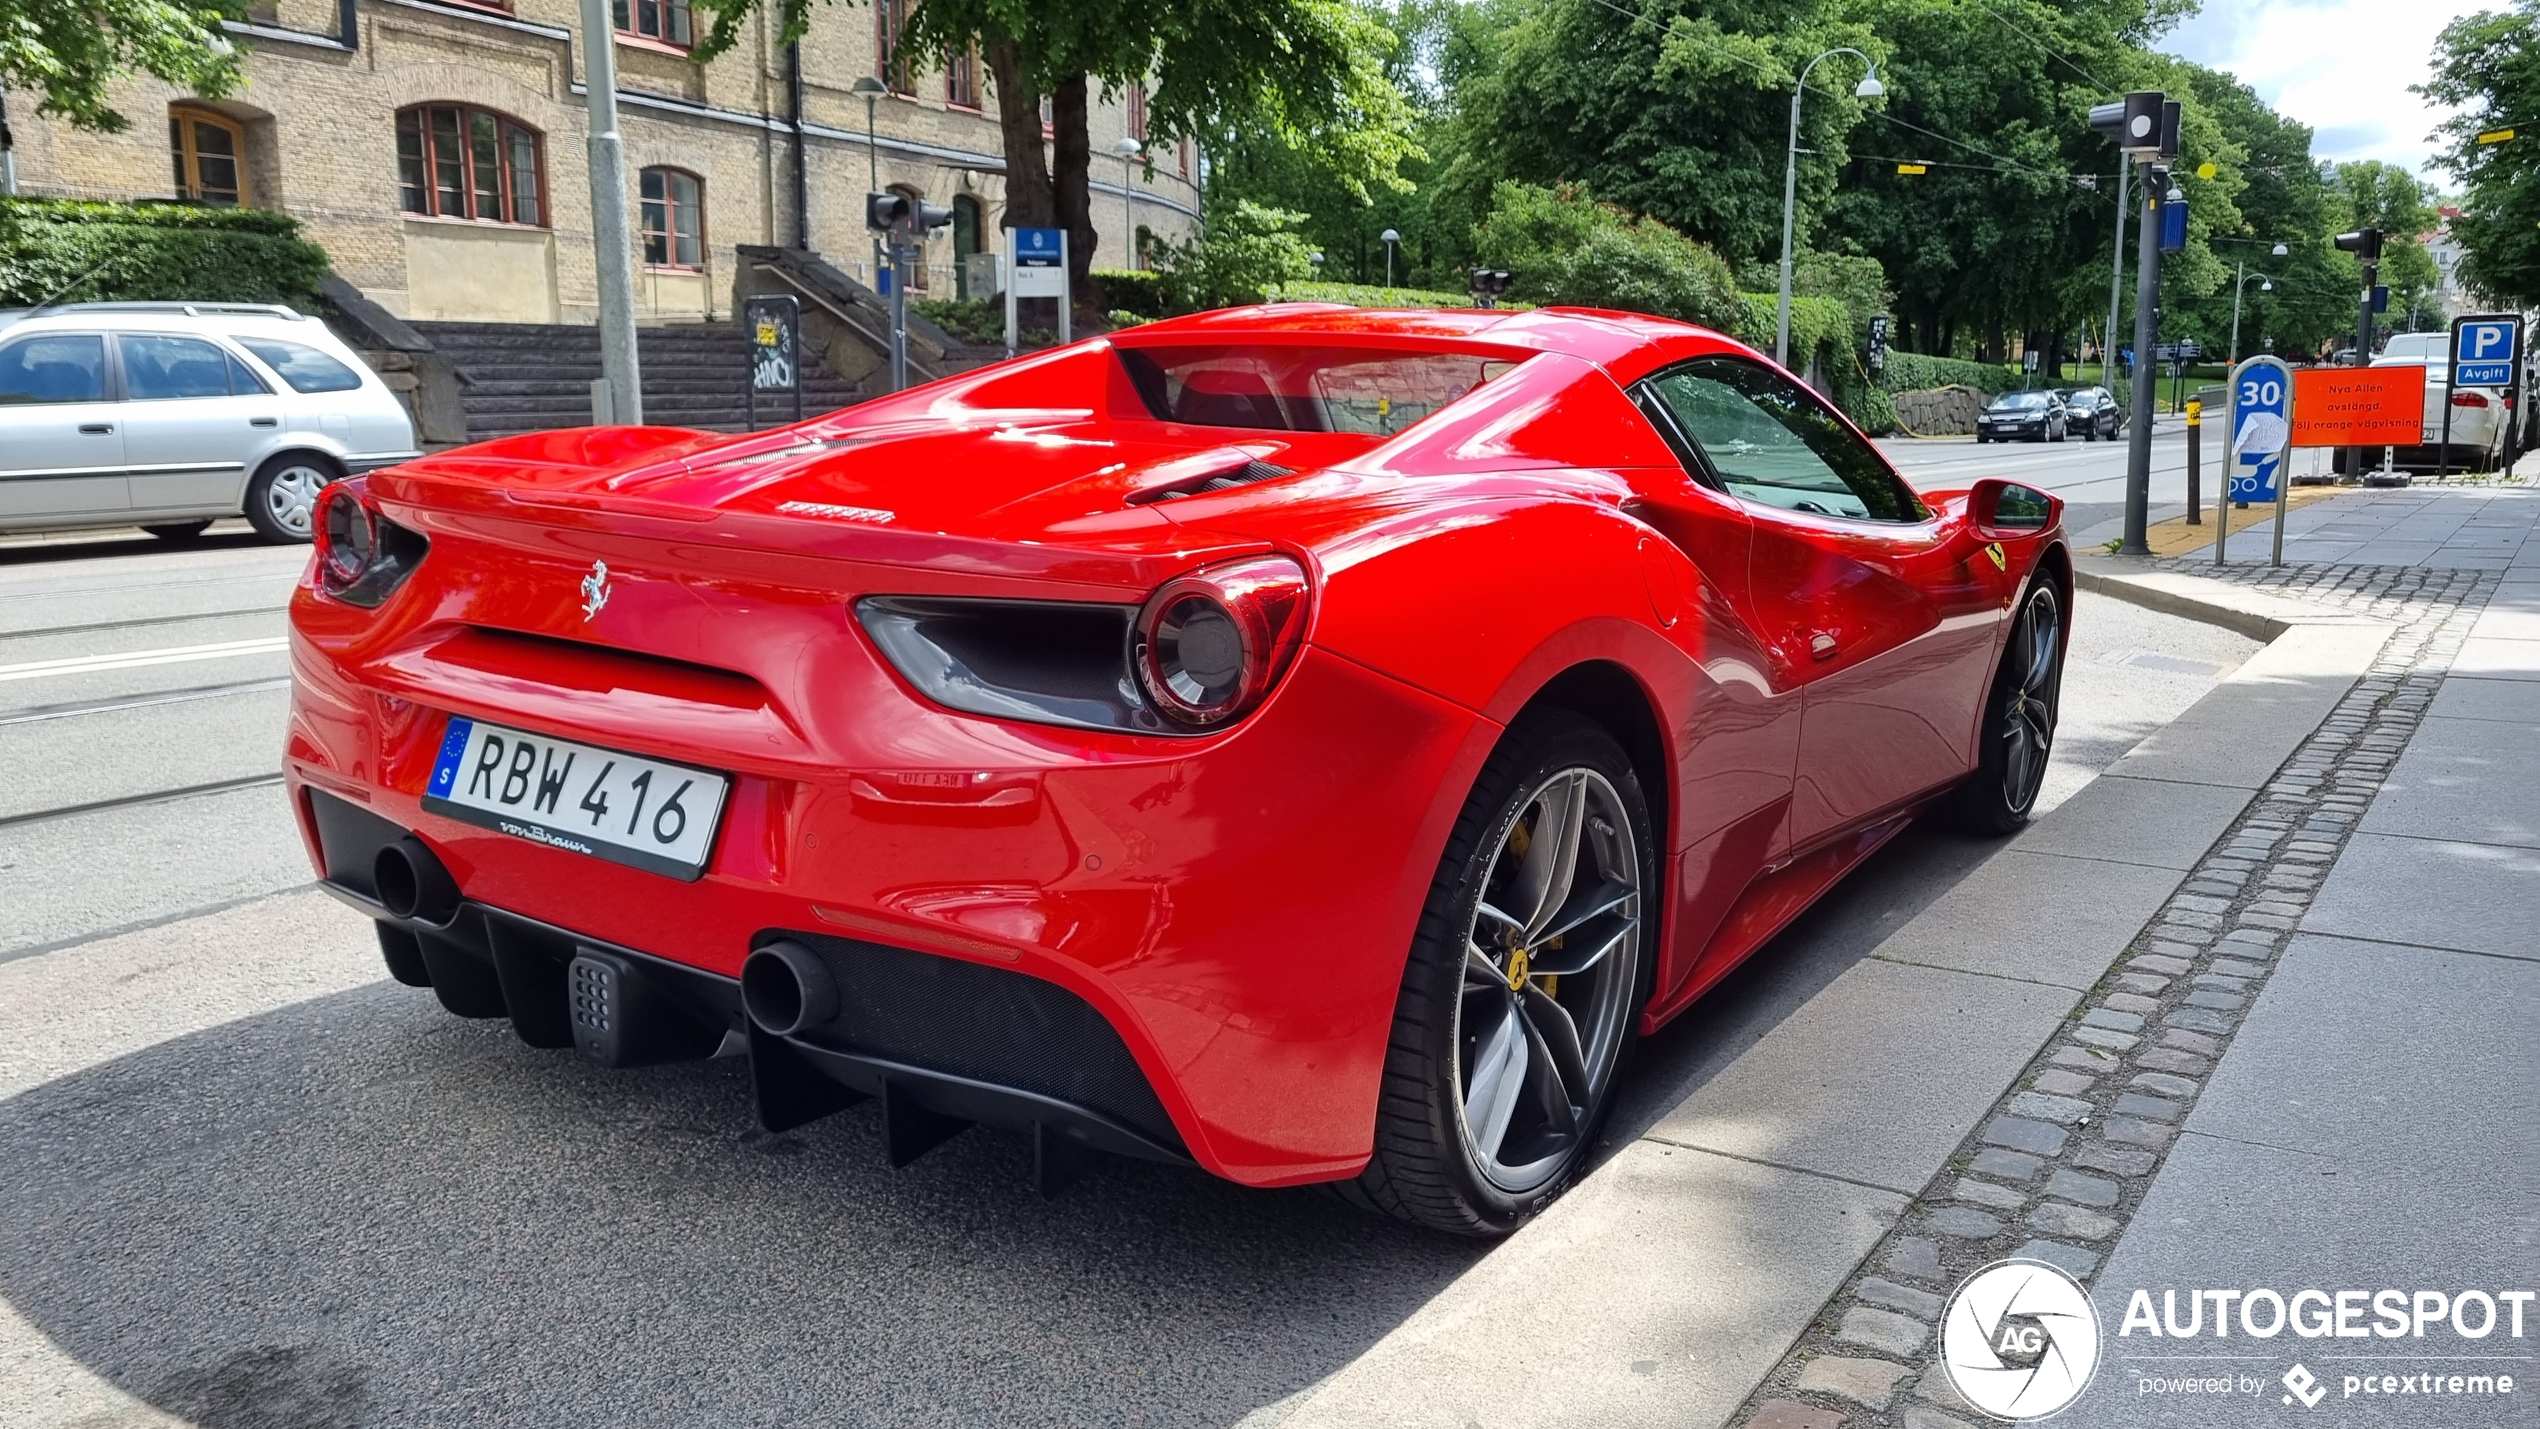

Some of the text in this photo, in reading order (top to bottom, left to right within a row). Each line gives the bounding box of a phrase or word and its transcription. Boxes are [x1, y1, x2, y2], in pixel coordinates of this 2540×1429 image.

[2475, 327, 2501, 358] P
[2464, 368, 2503, 380] Avgift
[2240, 381, 2280, 406] 30
[2329, 385, 2351, 395] Nya
[2327, 402, 2383, 412] avstängd.
[2314, 421, 2353, 430] orange
[2357, 418, 2419, 430] vägvisning
[438, 767, 451, 785] S
[468, 734, 694, 843] RBW 416
